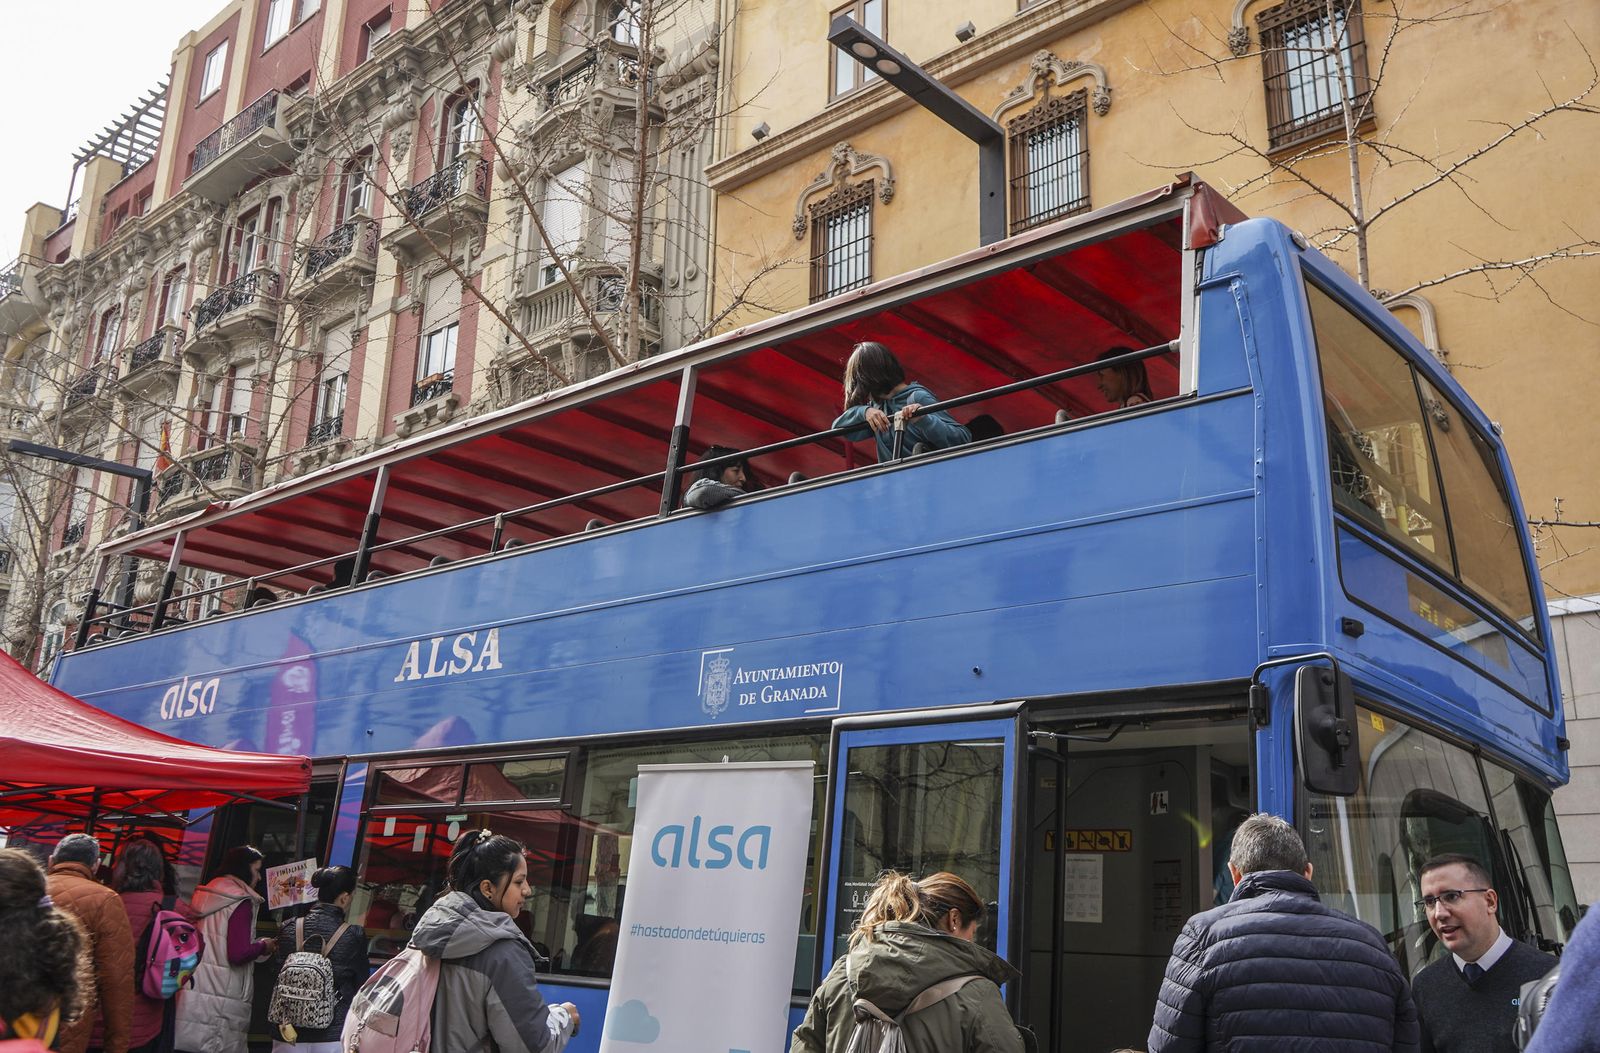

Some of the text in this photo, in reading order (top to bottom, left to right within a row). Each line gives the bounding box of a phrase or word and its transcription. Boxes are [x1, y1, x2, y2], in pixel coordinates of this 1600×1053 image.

[393, 627, 503, 683] ALSA
[732, 660, 840, 686] AYUNTAMIENTO
[160, 675, 220, 720] alsa
[760, 685, 828, 704] GRANADA
[651, 815, 772, 870] alsa
[630, 923, 766, 945] #hastadondetúquieras
[1511, 997, 1521, 1006] al
